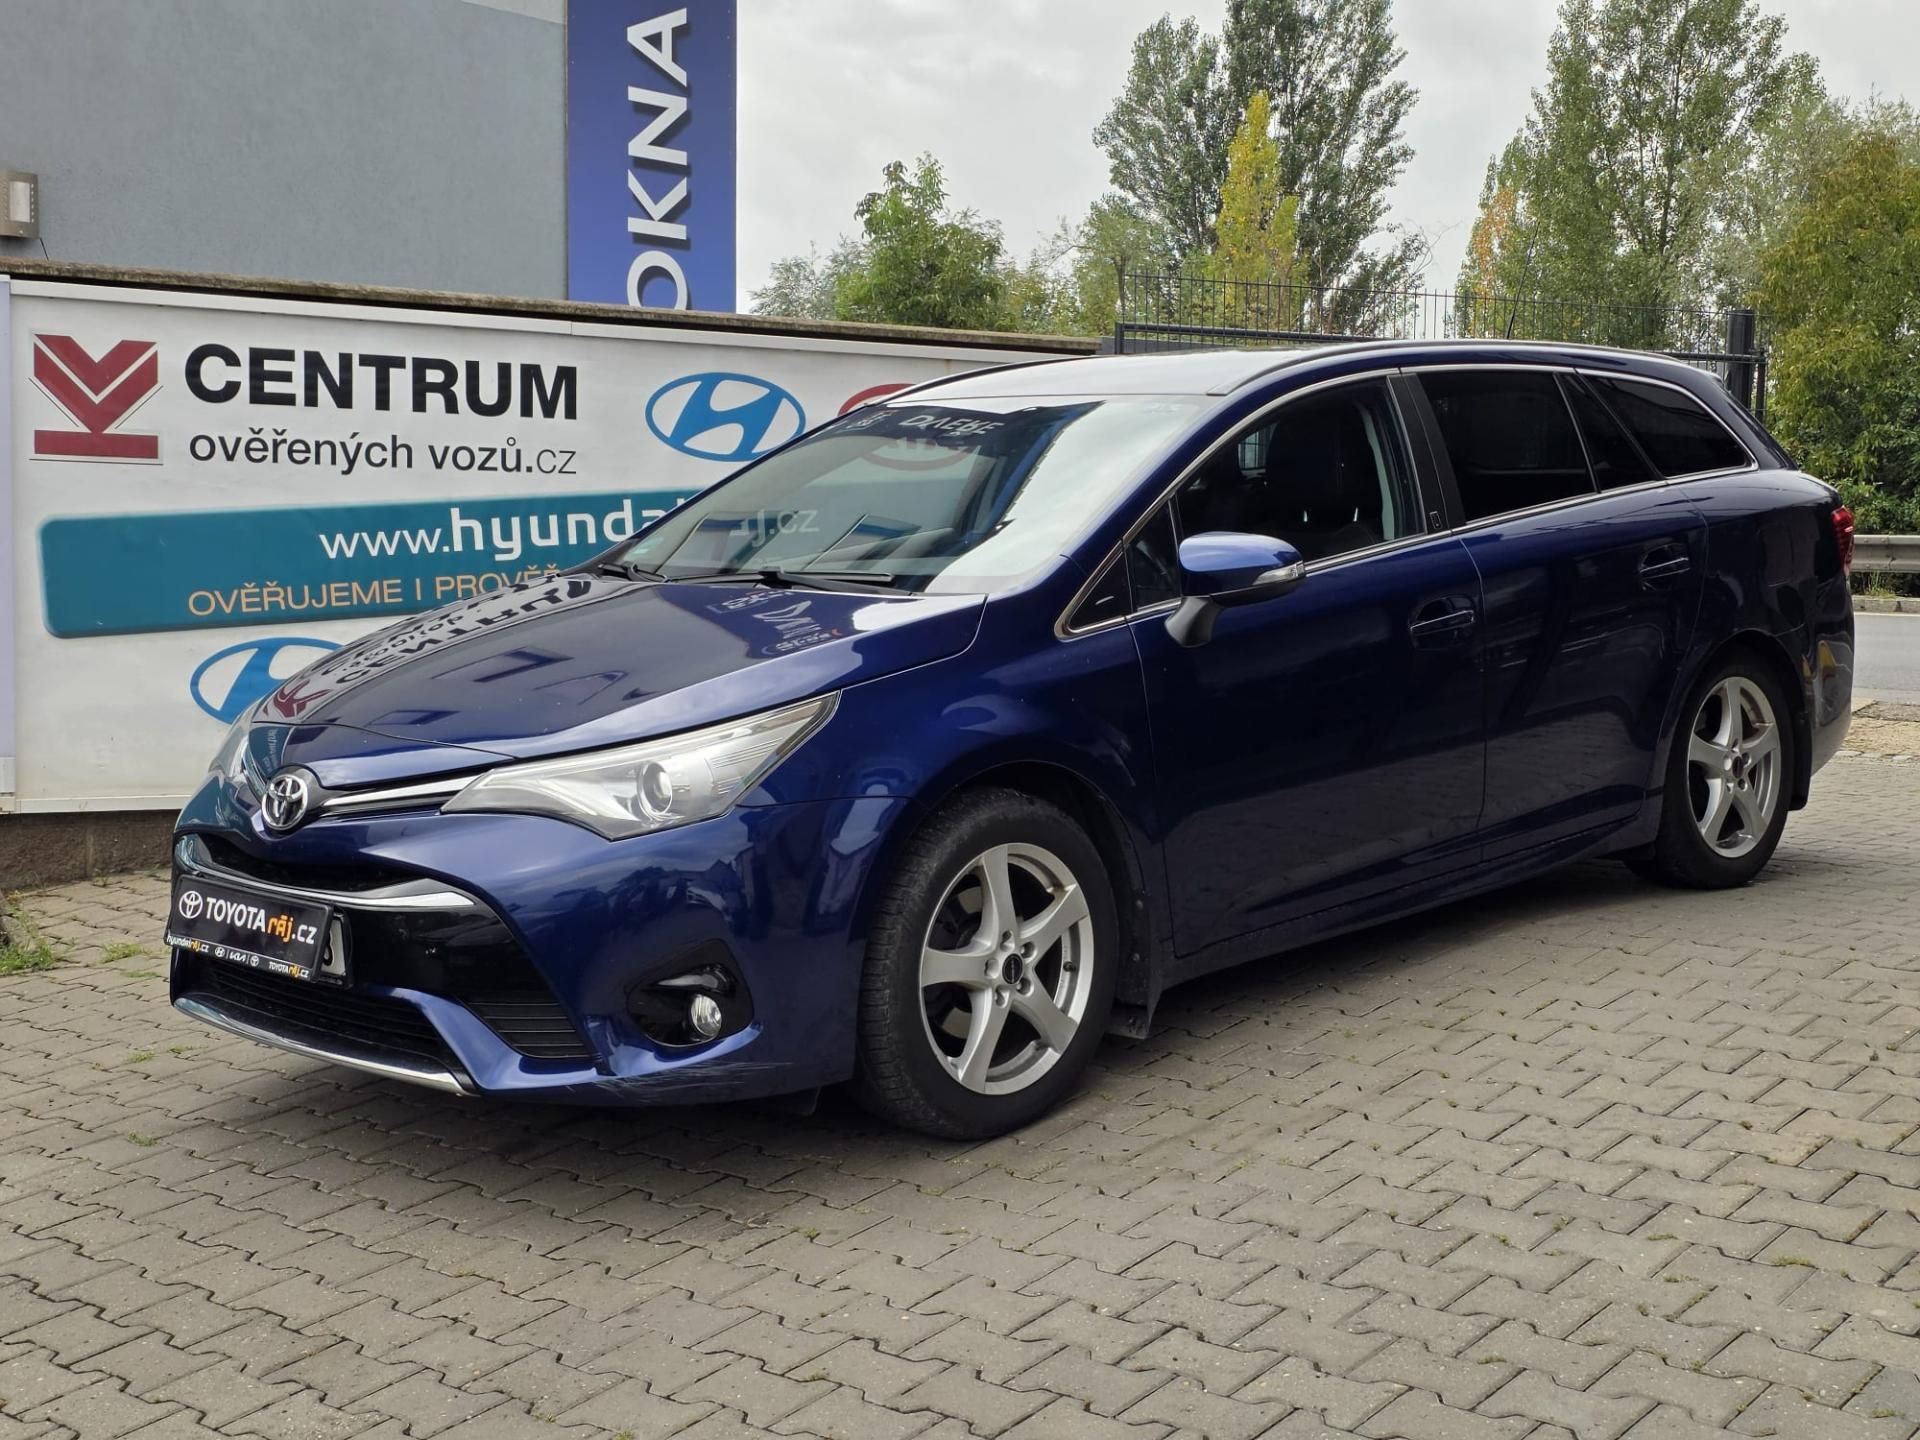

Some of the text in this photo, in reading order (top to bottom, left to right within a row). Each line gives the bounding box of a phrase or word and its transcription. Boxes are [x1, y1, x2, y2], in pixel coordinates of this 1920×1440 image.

[626, 7, 688, 311] OKNA
[184, 343, 577, 420] CENTRUM
[189, 427, 577, 476] ověřených vozů.cz
[188, 579, 403, 616] OVĚŘUJEME
[415, 577, 422, 601] I
[206, 897, 318, 946] TOYOTAráj.cz
